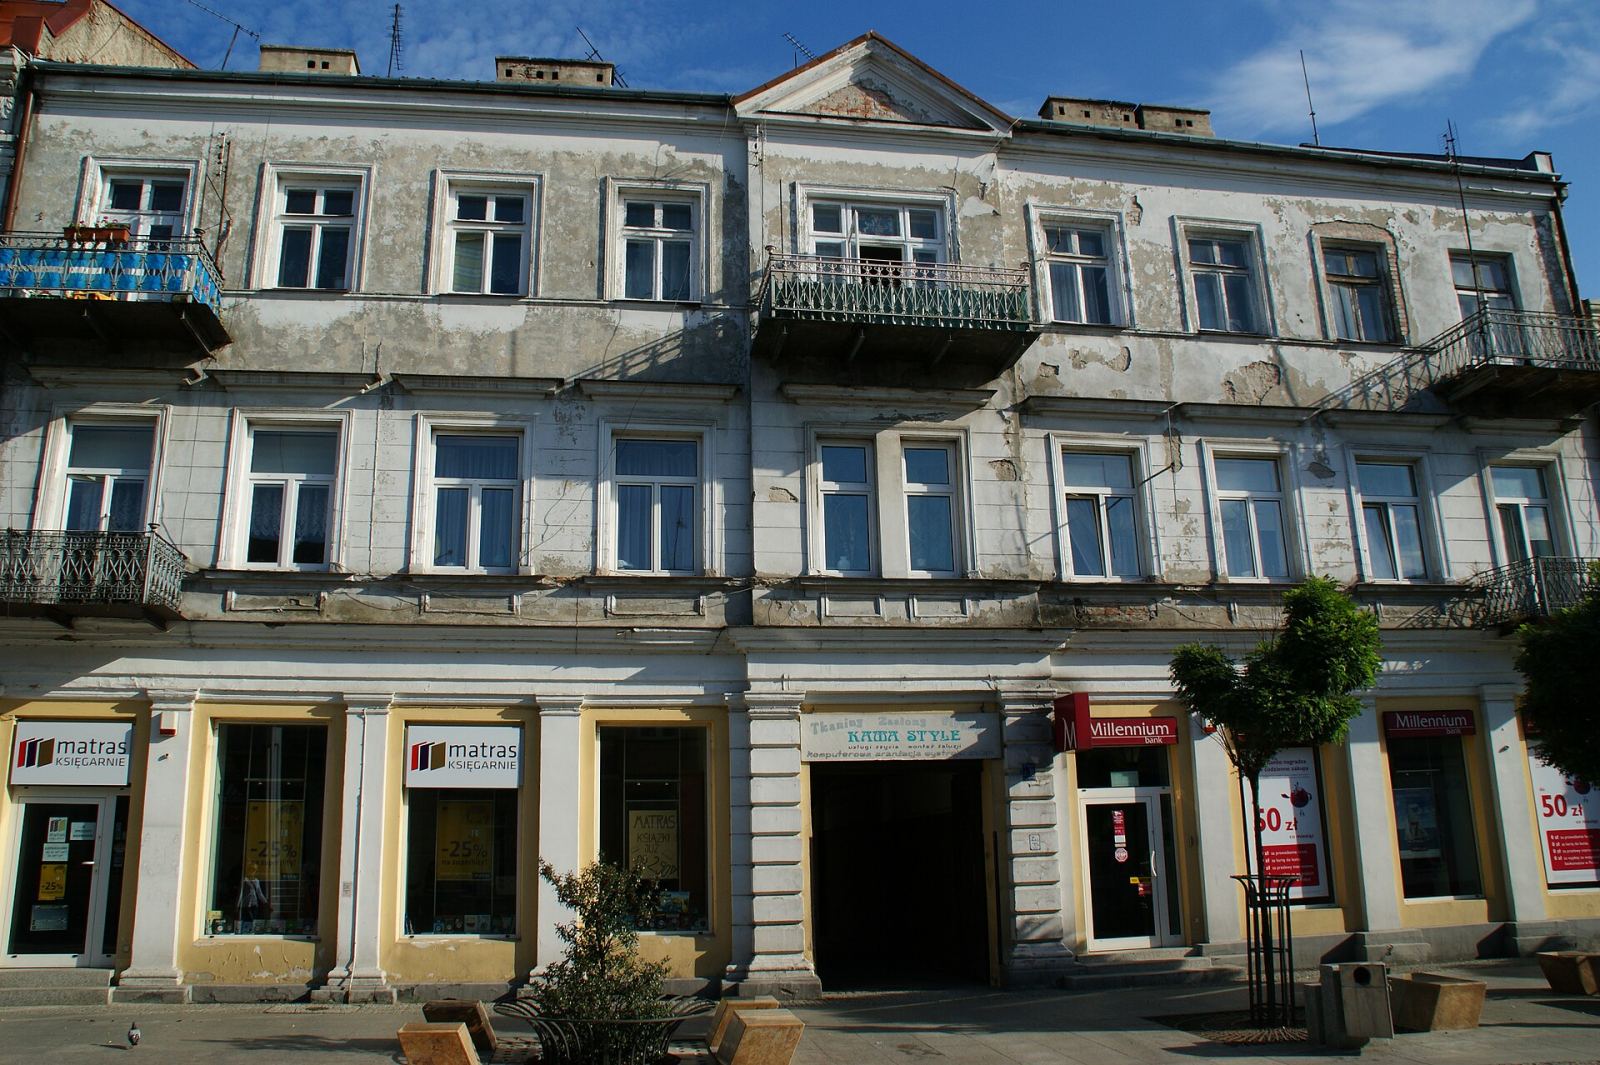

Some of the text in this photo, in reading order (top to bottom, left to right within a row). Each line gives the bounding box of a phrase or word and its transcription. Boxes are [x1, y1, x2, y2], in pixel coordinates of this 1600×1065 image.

[1395, 712, 1467, 728] Millennium
[907, 730, 961, 742] STYLE
[1062, 717, 1077, 751] M
[1090, 722, 1169, 736] Millennium
[57, 738, 127, 754] matras
[1144, 736, 1163, 744] bank
[449, 742, 517, 758] matras
[56, 757, 125, 768] KSIĘGARNIE
[448, 760, 516, 772] KSIĘGARNIE
[1541, 794, 1583, 818] 50 zł
[633, 814, 676, 829] MATRAS
[1256, 807, 1298, 832] 50 zł
[251, 841, 297, 857] -25%
[441, 841, 488, 857] -25%
